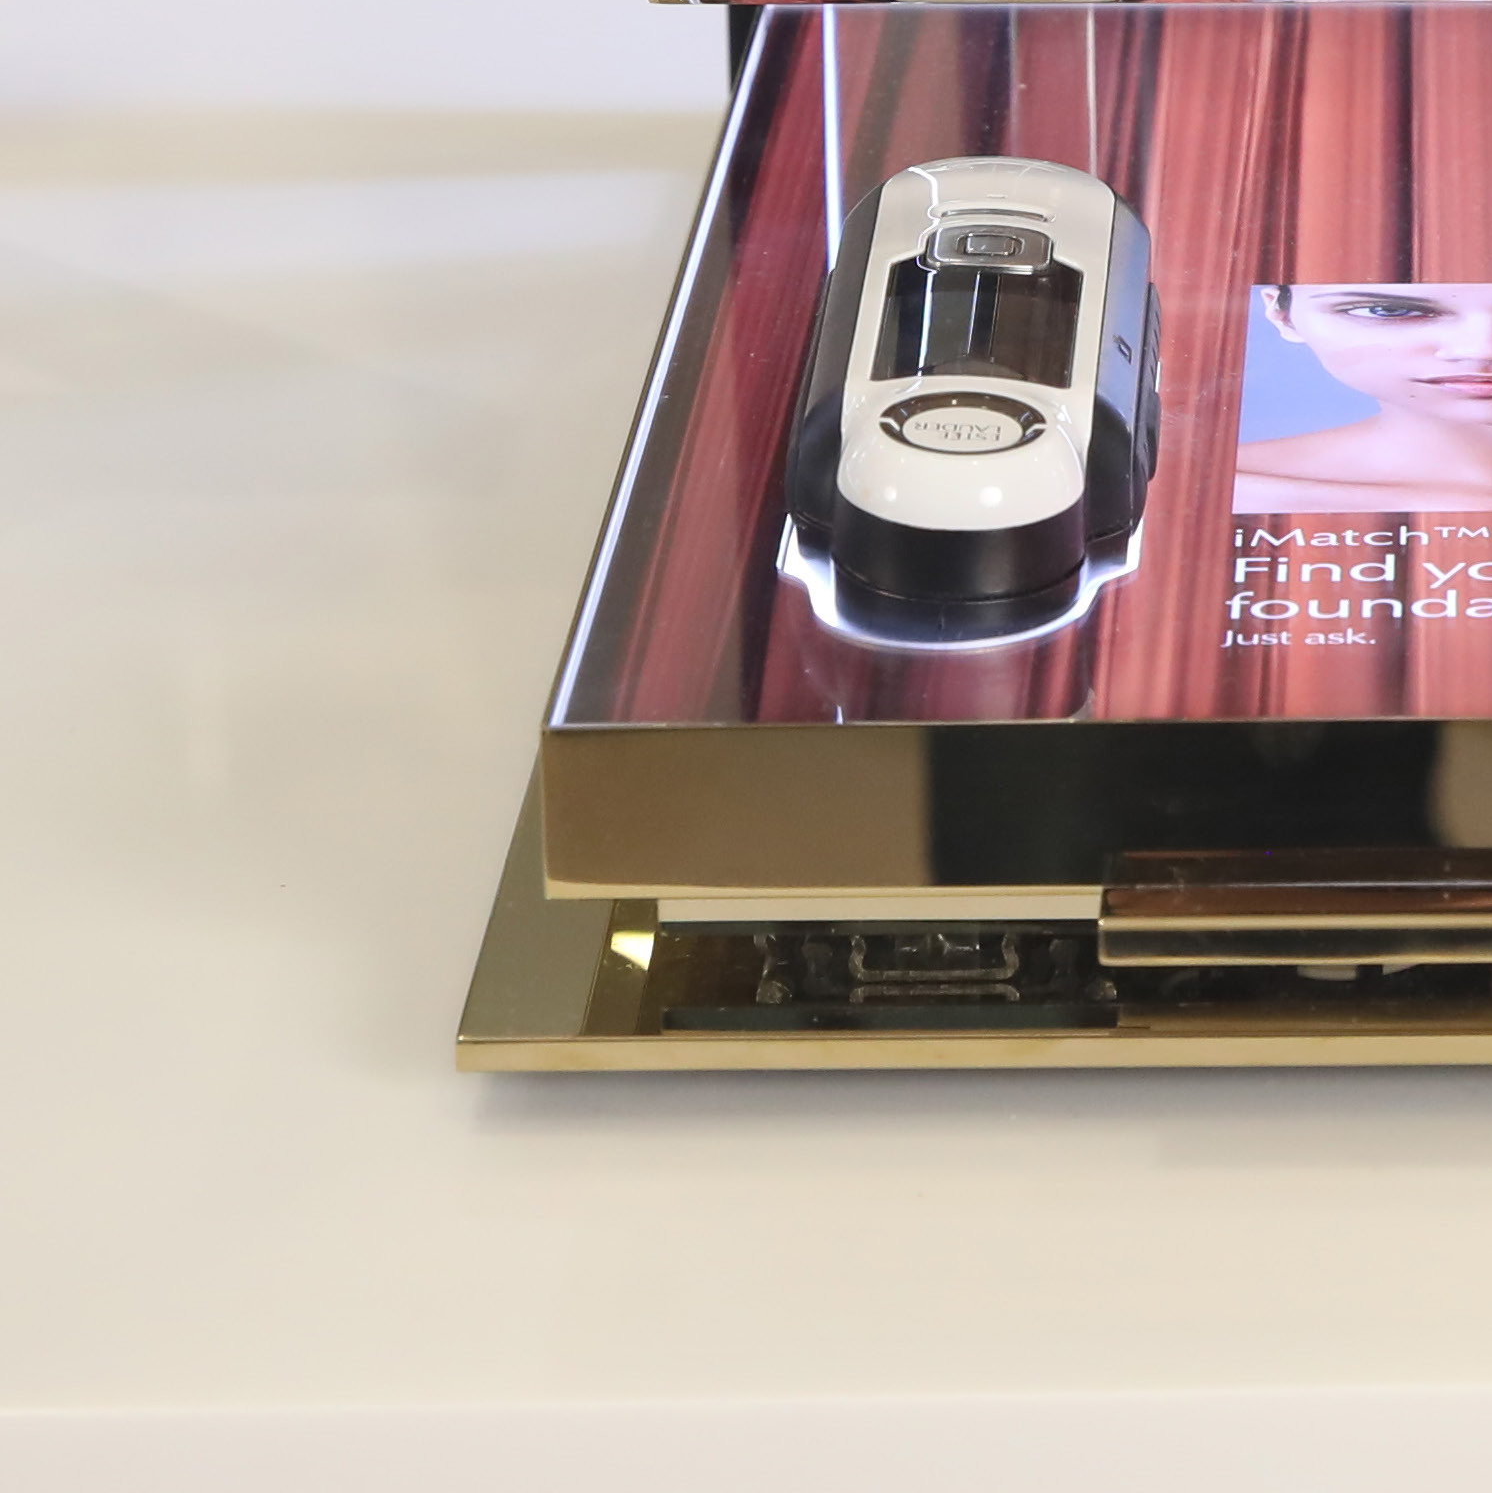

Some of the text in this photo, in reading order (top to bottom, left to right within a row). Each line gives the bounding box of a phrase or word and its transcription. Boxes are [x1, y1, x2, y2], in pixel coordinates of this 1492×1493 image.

[1233, 554, 1397, 584] Find
[1220, 627, 1377, 649] Just ask.
